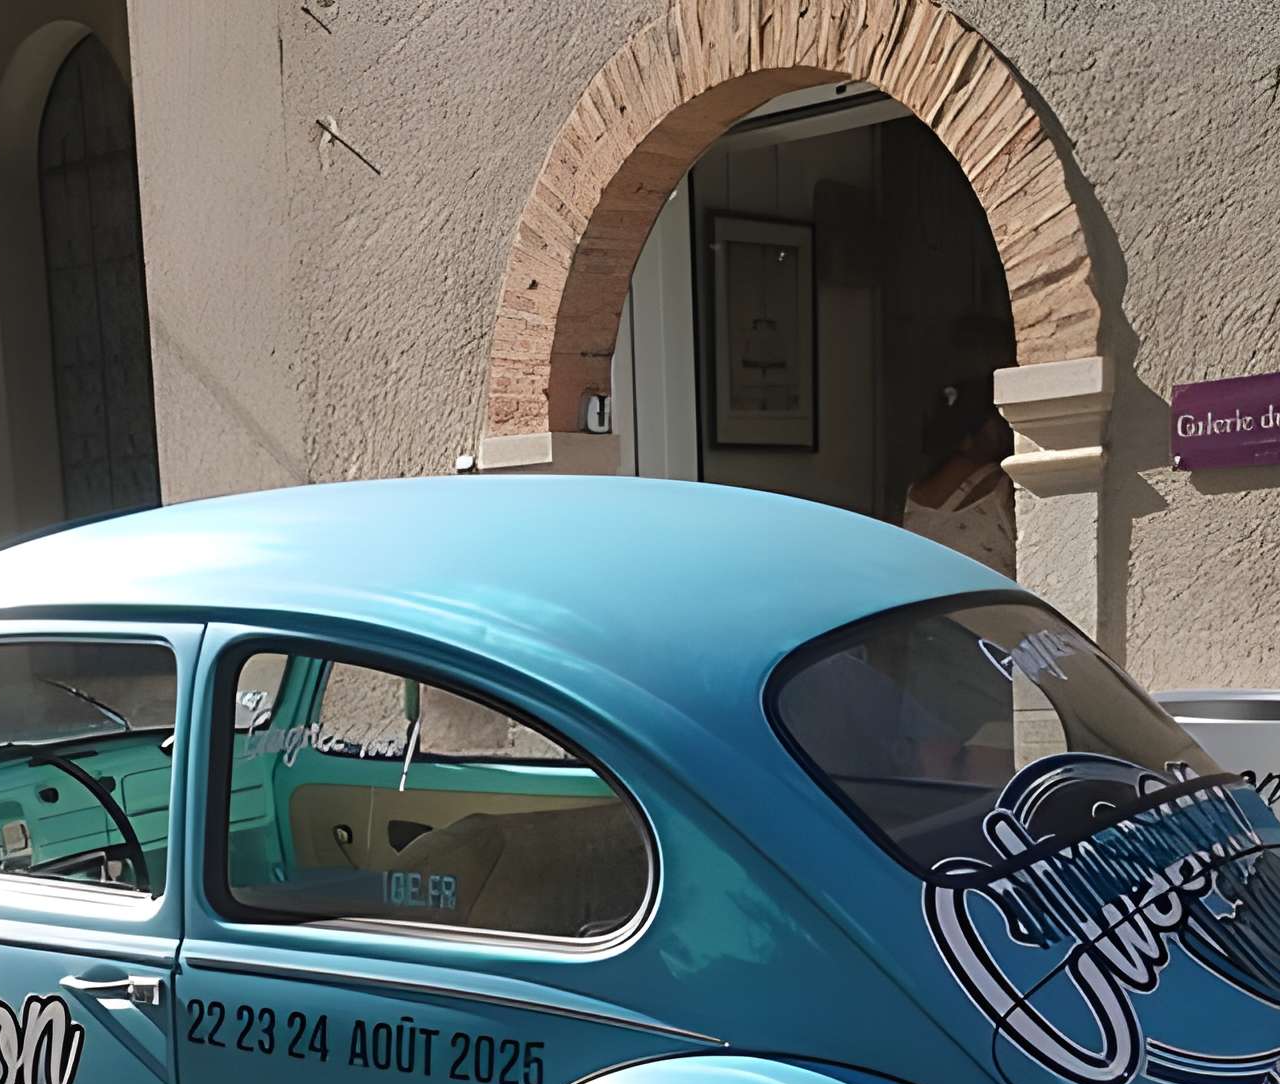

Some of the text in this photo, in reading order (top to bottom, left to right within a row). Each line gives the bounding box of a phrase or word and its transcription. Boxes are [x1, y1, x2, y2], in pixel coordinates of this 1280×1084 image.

[1177, 408, 1254, 438] Galerie
[186, 998, 227, 1049] 22
[236, 1004, 276, 1055] 23
[287, 1011, 330, 1062] 24
[347, 1016, 441, 1077] AOÛT
